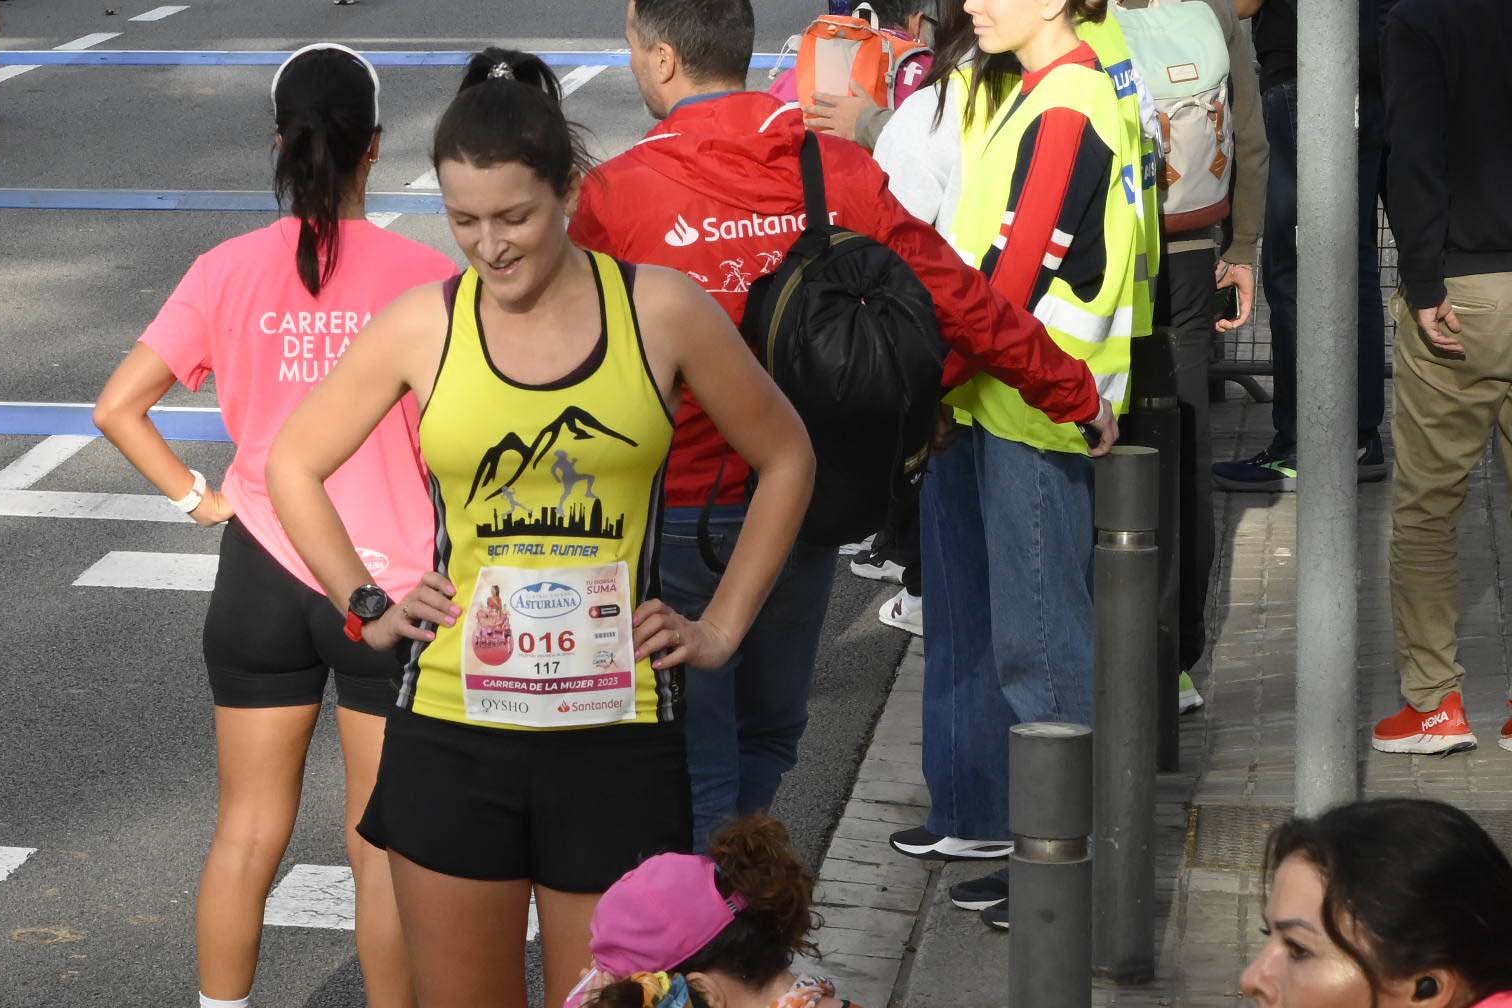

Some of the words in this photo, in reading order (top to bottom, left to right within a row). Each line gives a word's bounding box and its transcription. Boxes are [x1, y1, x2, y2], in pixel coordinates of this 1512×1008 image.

[283, 335, 314, 358] DE
[487, 544, 510, 557] BCN
[512, 543, 548, 556] TRAIL
[550, 544, 599, 558] RUNNER
[586, 584, 617, 595] SUMA
[515, 595, 577, 610] ASTURIANA
[518, 630, 577, 654] 016
[534, 661, 561, 675] 117
[482, 679, 527, 690] CARRERA
[529, 682, 543, 691] DE
[545, 682, 558, 691] LA
[560, 679, 594, 690] MUJER
[481, 698, 529, 714] OYSHO
[571, 698, 623, 713] Santander
